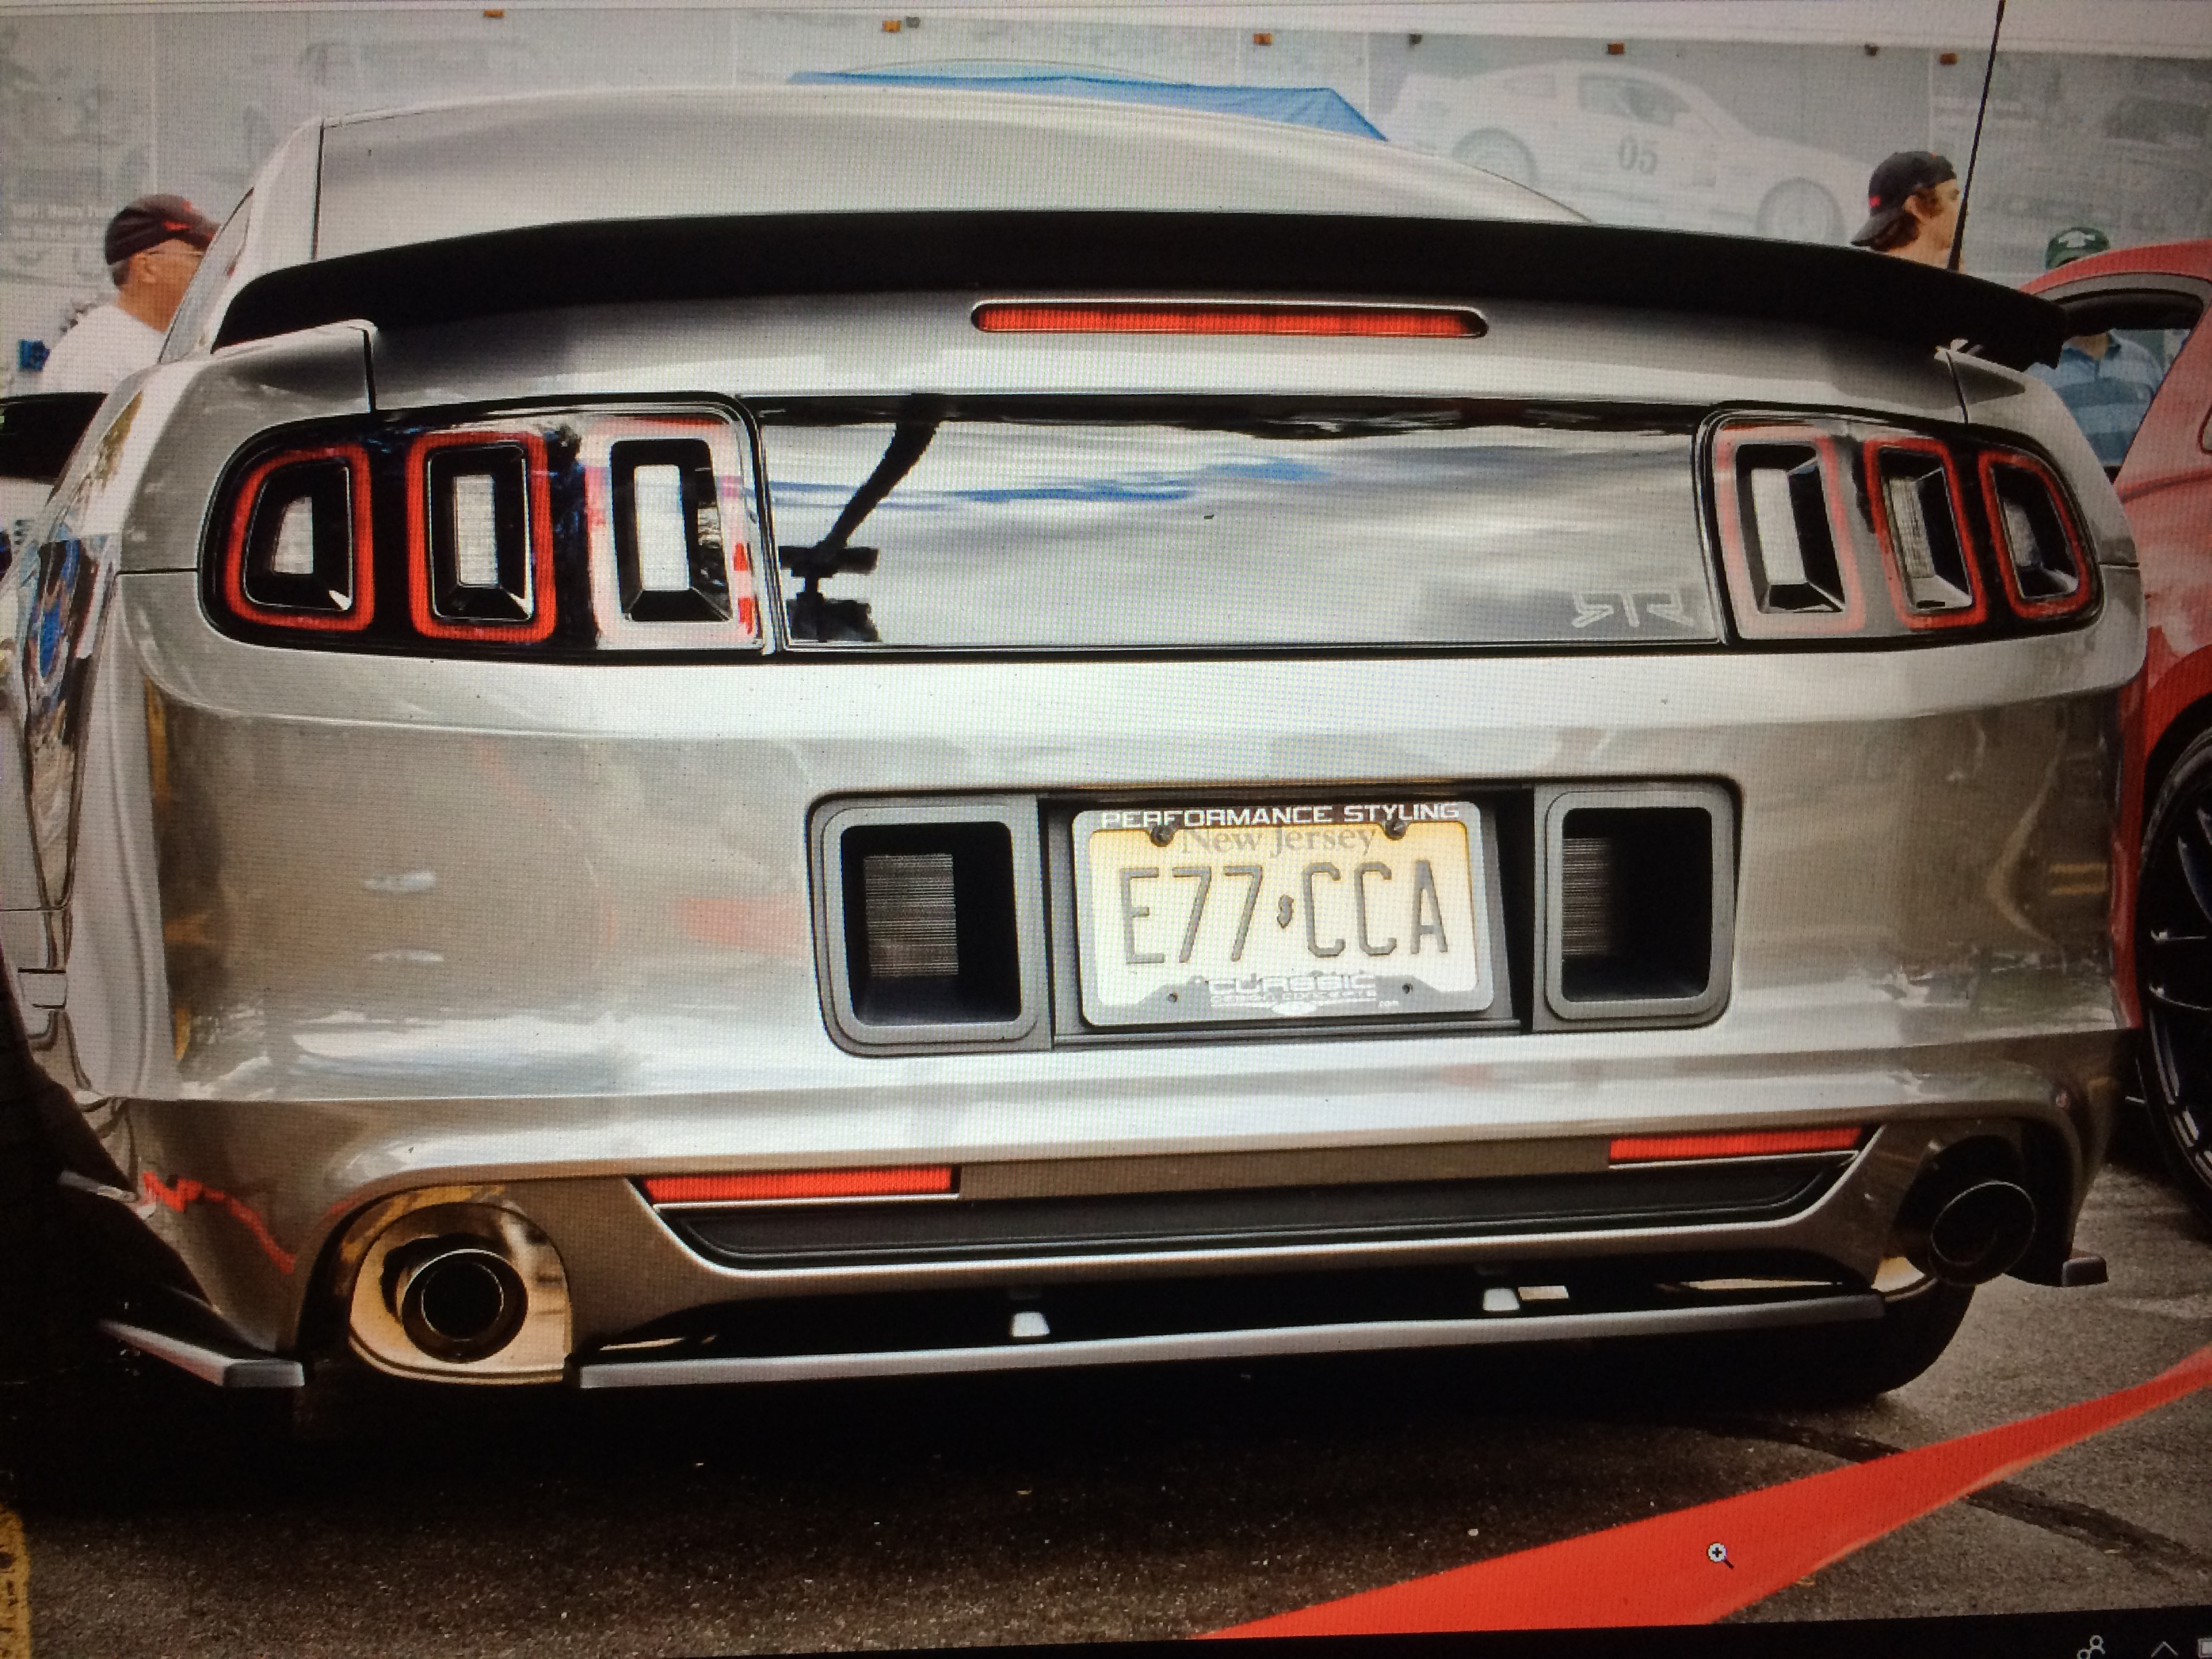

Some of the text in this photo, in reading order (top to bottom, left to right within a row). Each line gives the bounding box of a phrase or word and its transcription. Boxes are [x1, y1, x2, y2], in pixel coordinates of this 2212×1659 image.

[1617, 136, 1658, 176] 05
[1103, 802, 1459, 828] PERFORMANCE STYLING
[1182, 827, 1376, 859] New Jersey
